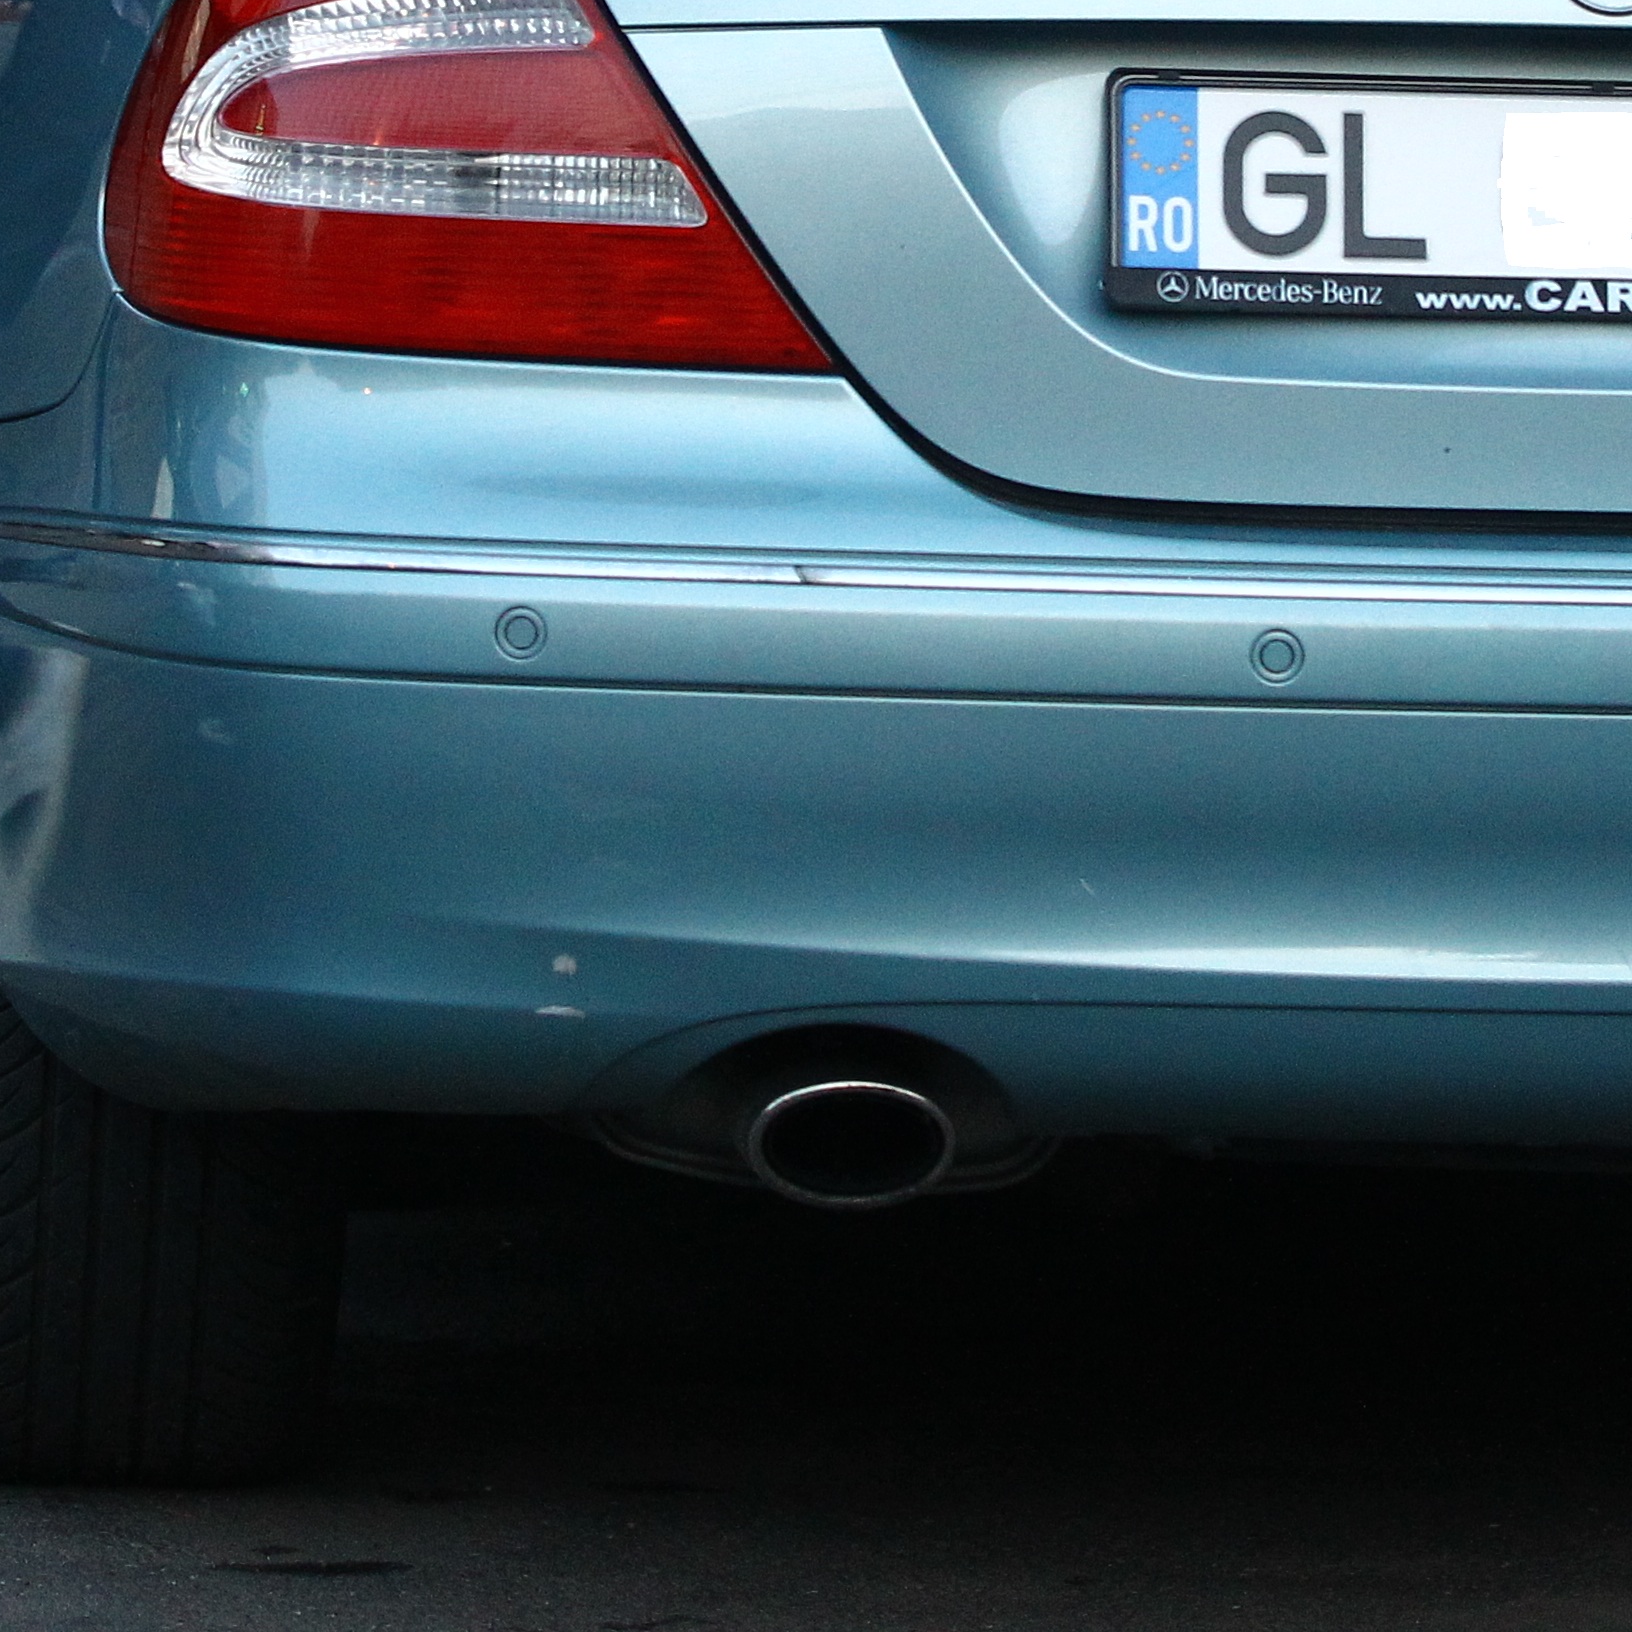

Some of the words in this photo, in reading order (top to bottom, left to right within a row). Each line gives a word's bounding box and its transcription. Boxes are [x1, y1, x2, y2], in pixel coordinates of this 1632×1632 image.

[1222, 111, 1427, 260] GL
[1128, 195, 1193, 253] RO
[1194, 275, 1383, 307] Mercedes-Benz
